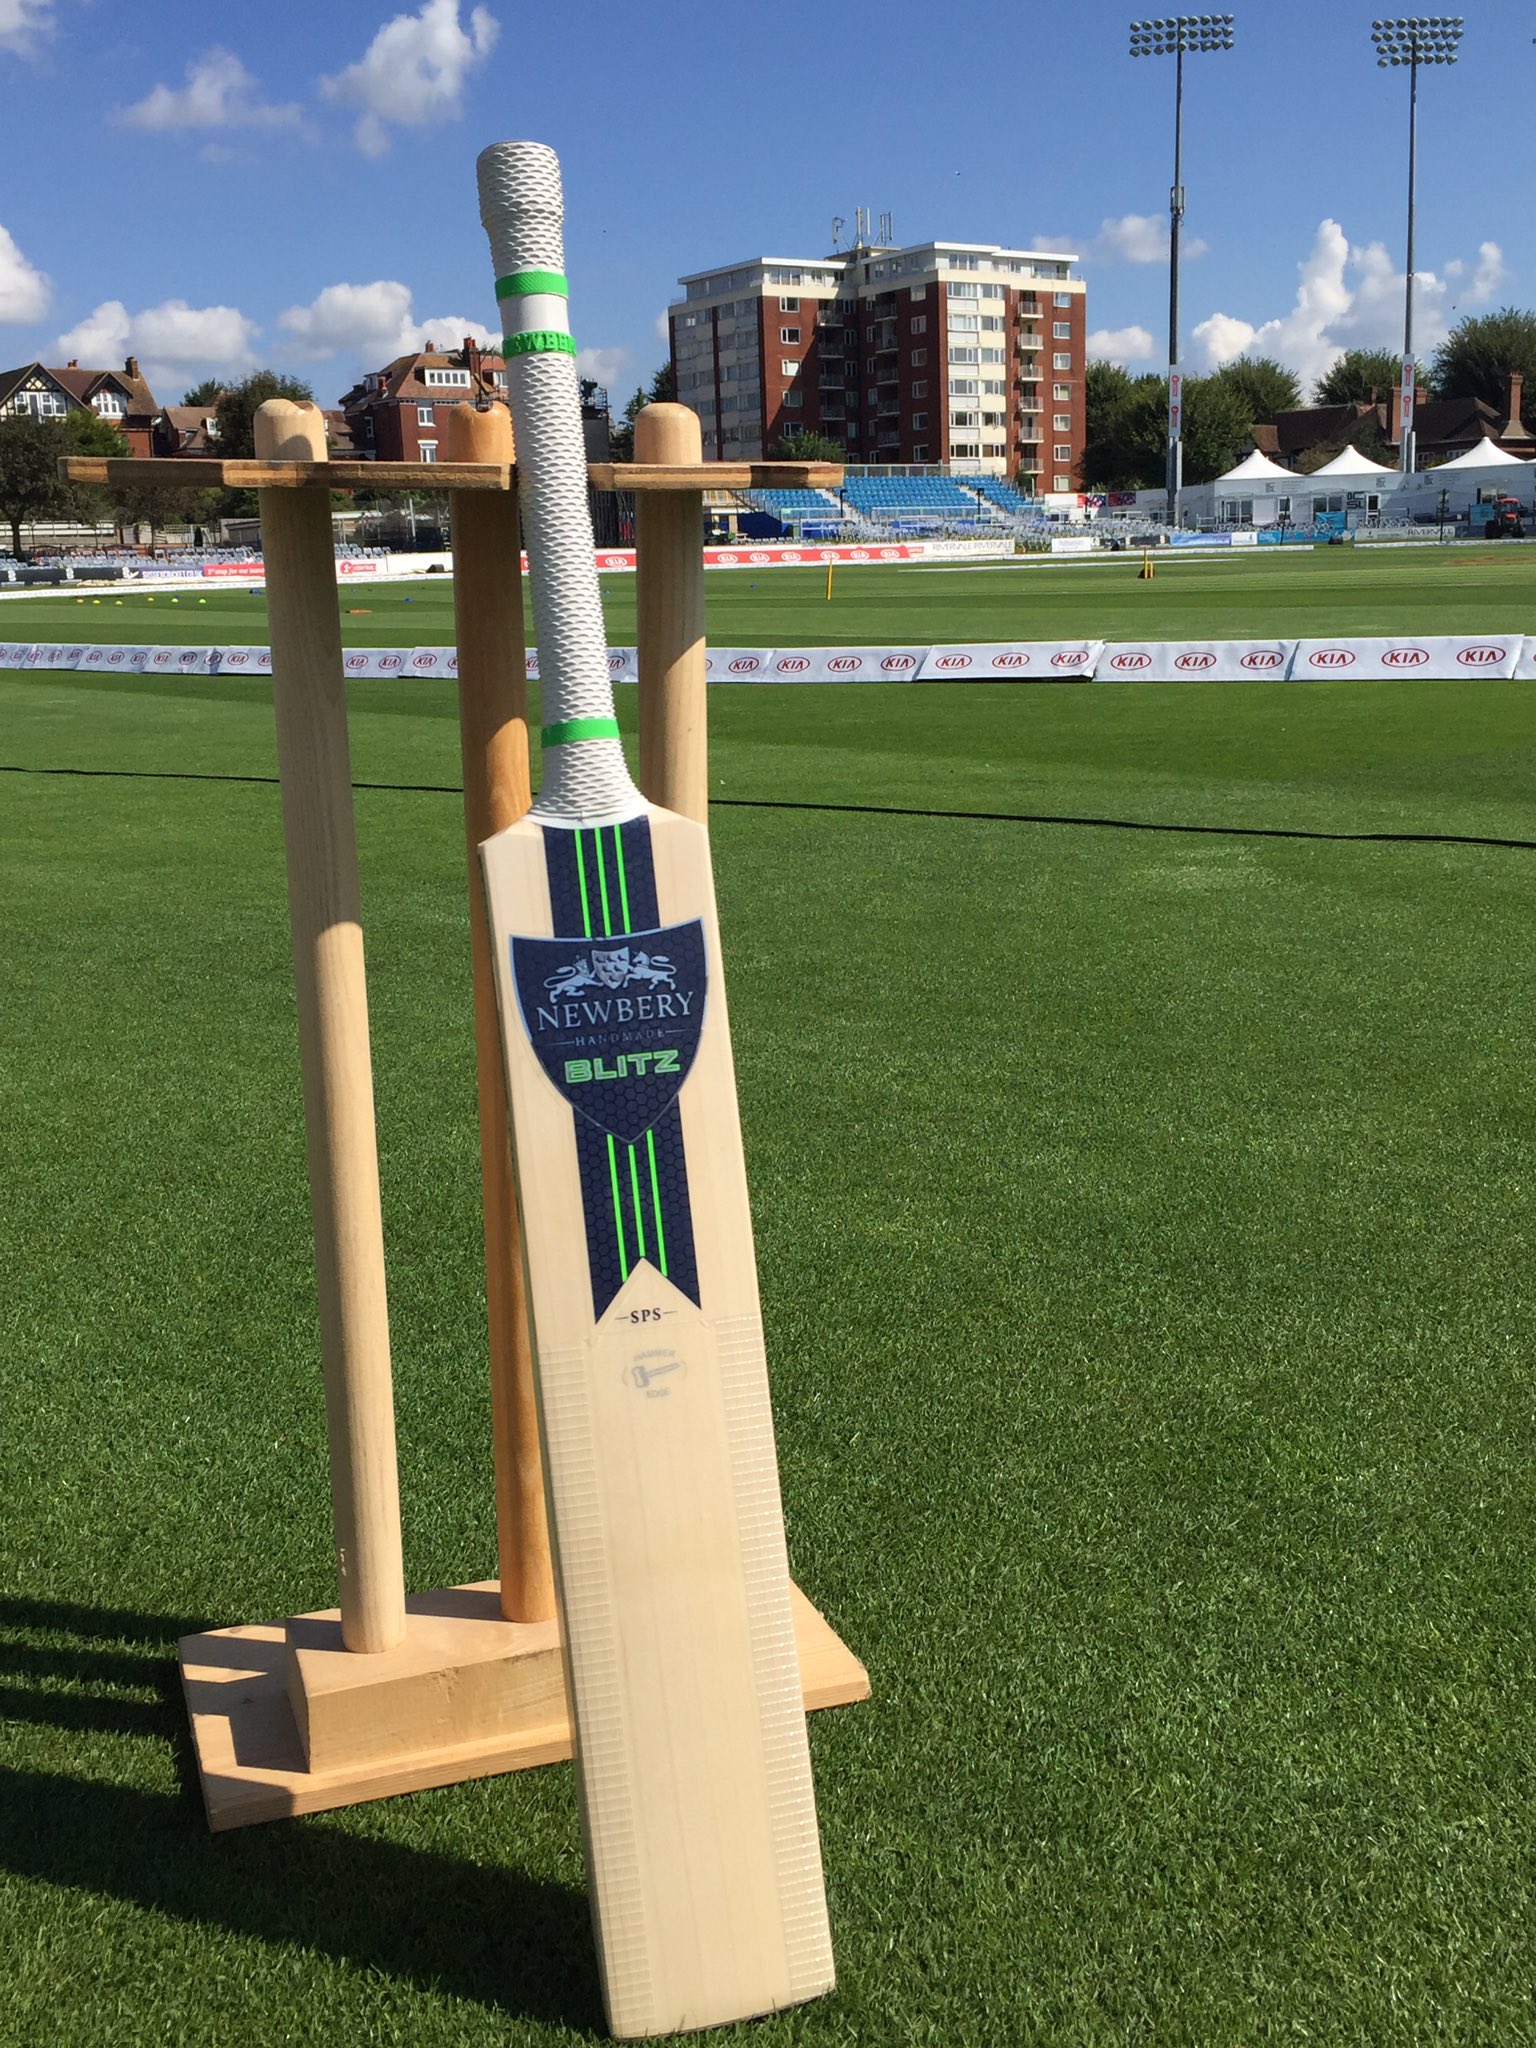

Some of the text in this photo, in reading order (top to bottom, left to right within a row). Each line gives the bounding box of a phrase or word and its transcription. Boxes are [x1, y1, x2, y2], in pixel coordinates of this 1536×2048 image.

[933, 543, 973, 551] RIVERVALE
[974, 541, 1013, 550] RIVERVALE
[537, 991, 694, 1031] NEWBERY
[576, 1029, 666, 1047] HANDMADE
[564, 1049, 681, 1084] BLITZ
[630, 1307, 662, 1324] SPS
